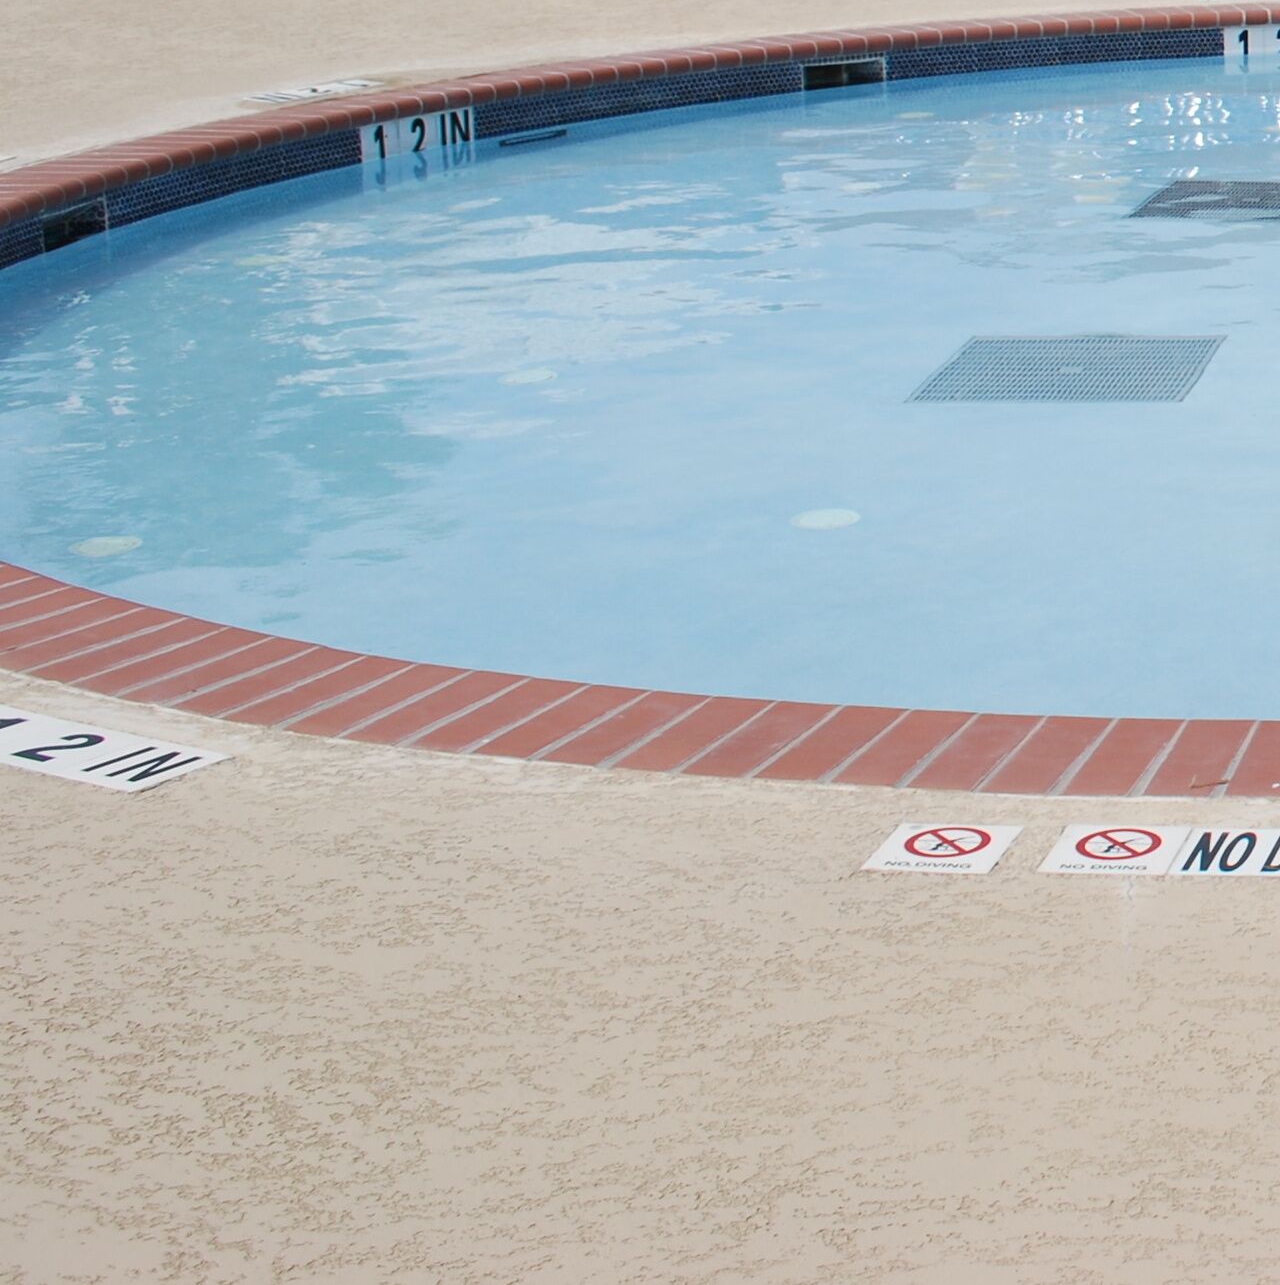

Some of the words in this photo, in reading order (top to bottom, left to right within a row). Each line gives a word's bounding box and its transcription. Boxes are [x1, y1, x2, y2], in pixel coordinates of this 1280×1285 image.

[440, 109, 471, 147] IN
[82, 746, 203, 782] IN
[1181, 832, 1257, 871] NO
